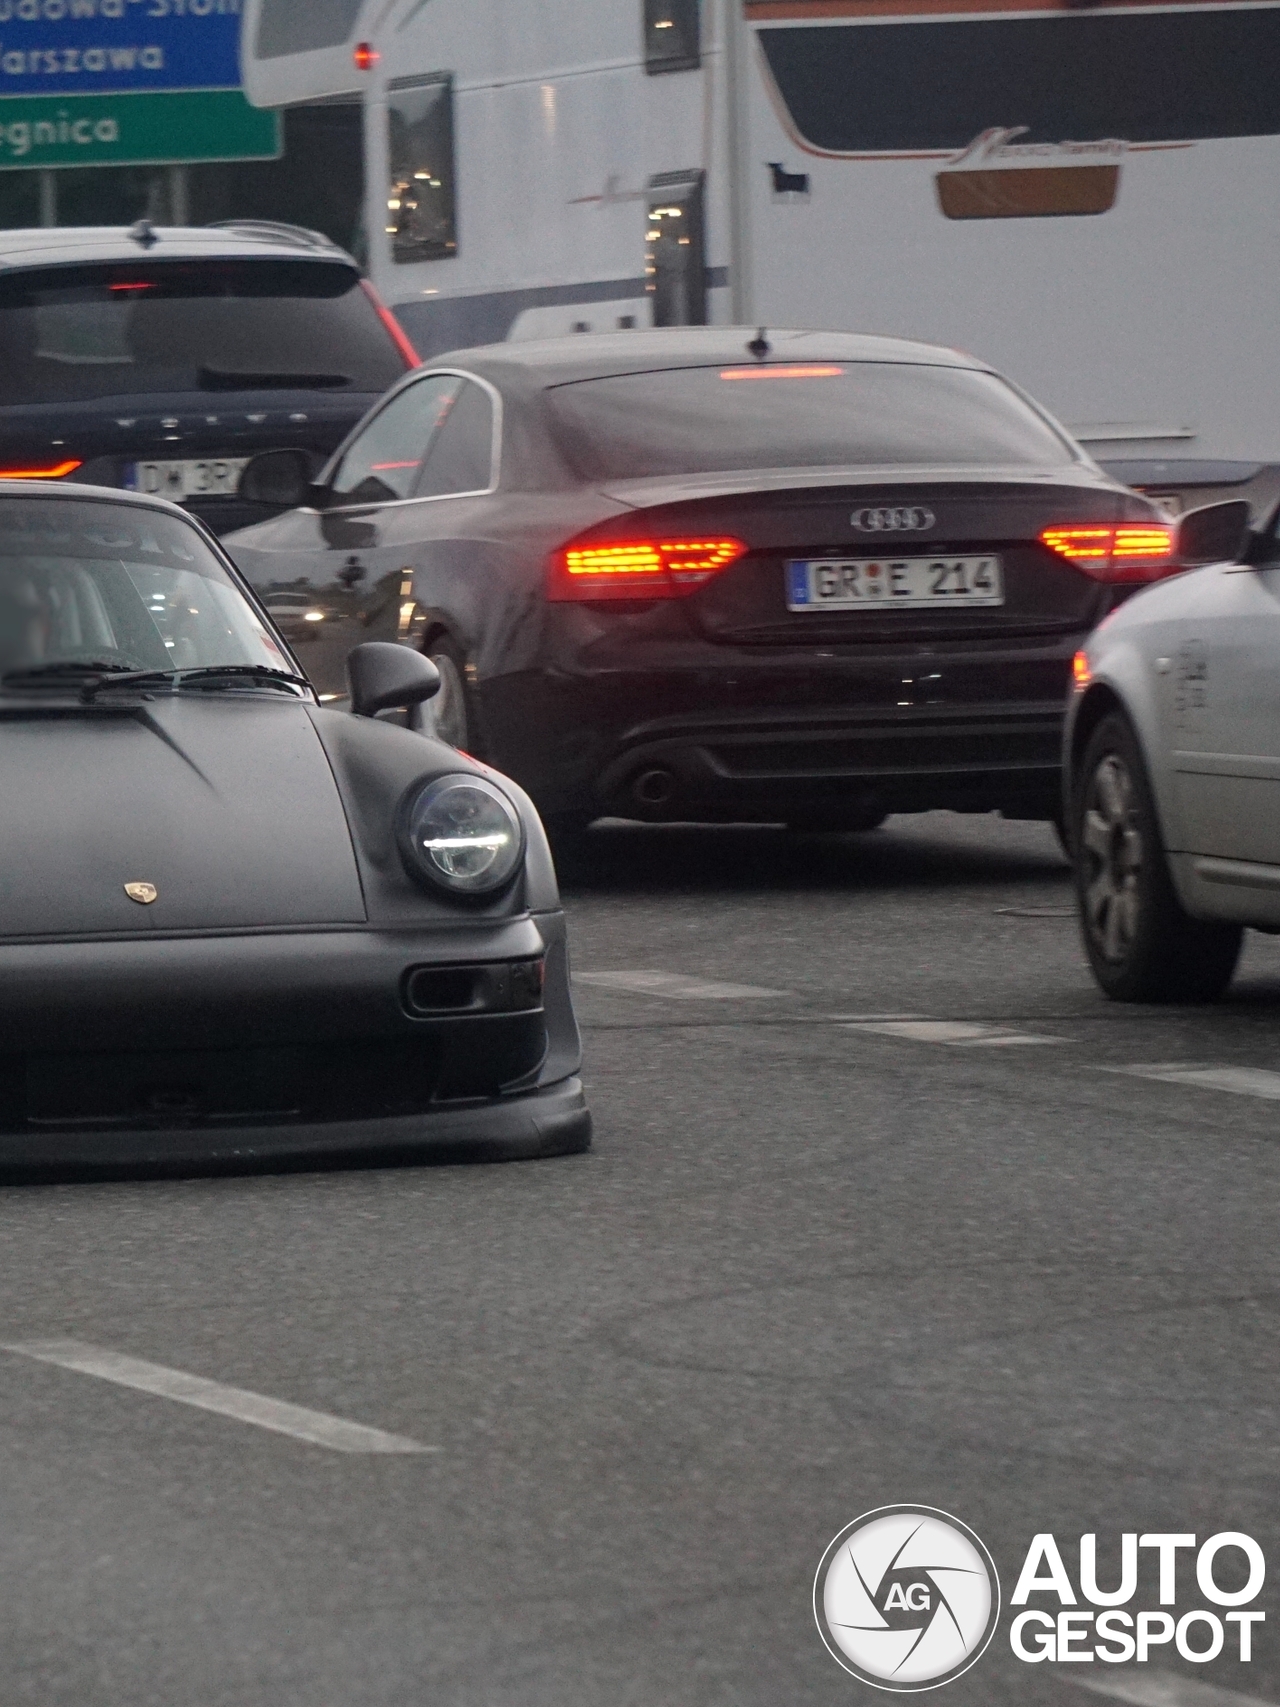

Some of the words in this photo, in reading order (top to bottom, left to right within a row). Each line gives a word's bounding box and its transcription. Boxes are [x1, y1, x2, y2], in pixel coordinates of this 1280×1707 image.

[816, 565, 861, 597] GR
[888, 563, 911, 596] E
[927, 561, 992, 594] 214
